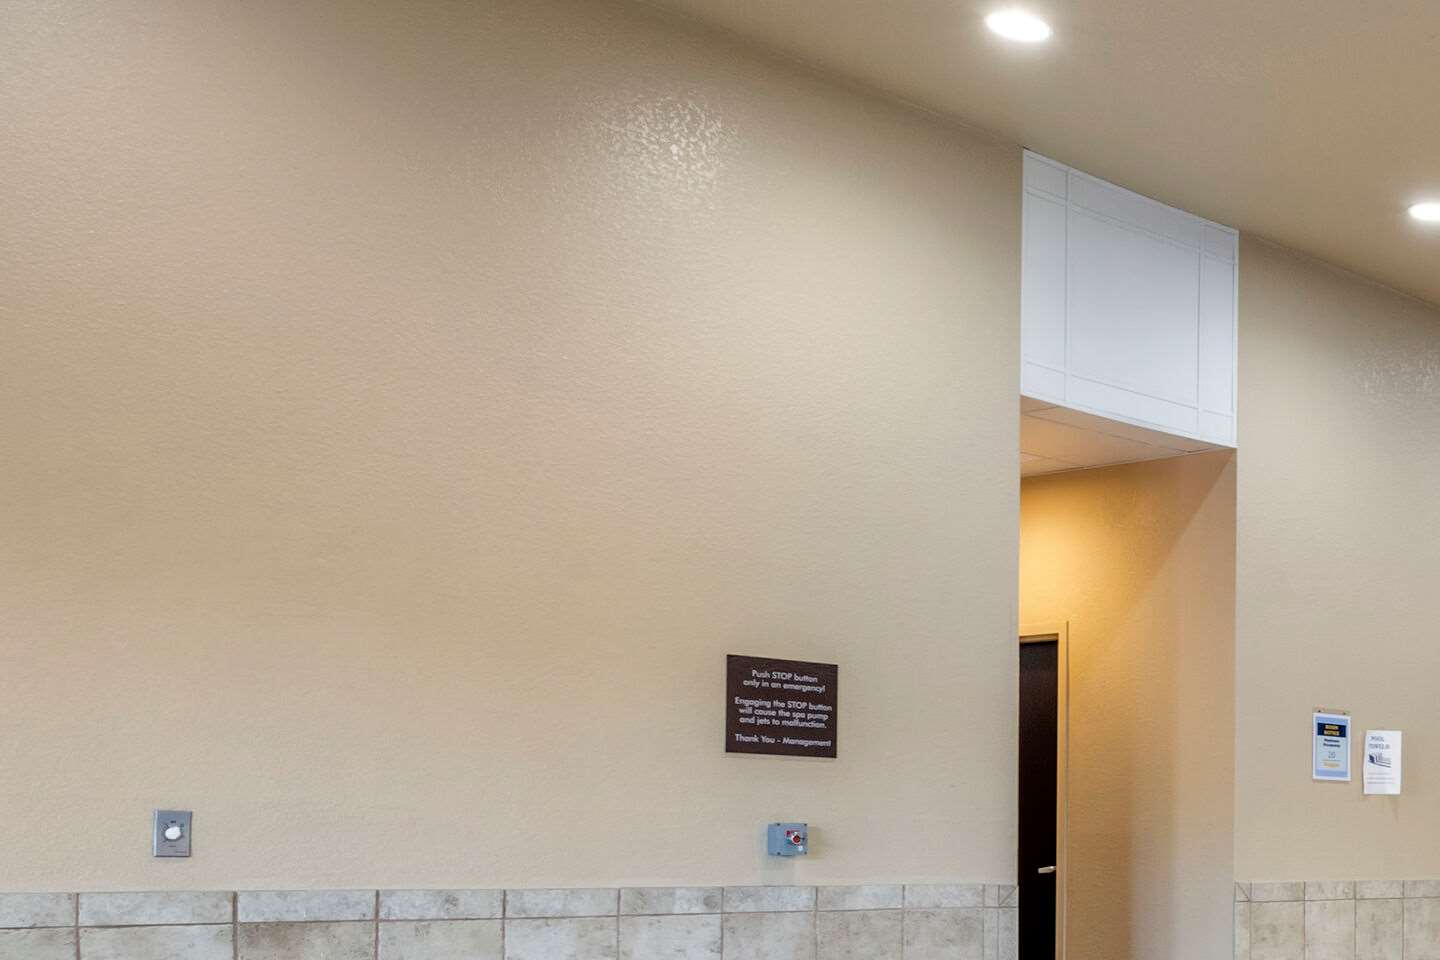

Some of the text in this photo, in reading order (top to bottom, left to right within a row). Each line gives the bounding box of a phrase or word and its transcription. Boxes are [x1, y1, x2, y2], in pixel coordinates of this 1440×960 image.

[751, 669, 818, 683] Push STOP button
[743, 679, 760, 689] only
[761, 680, 769, 688] in
[735, 697, 833, 712] Engaging the STOP button
[739, 706, 753, 714] will
[778, 709, 791, 717] the
[792, 711, 806, 719] spa
[807, 713, 829, 721] pump
[756, 717, 771, 726] jets
[771, 718, 781, 726] to
[735, 733, 760, 743] Thank
[760, 735, 776, 744] You
[782, 737, 832, 747] Management
